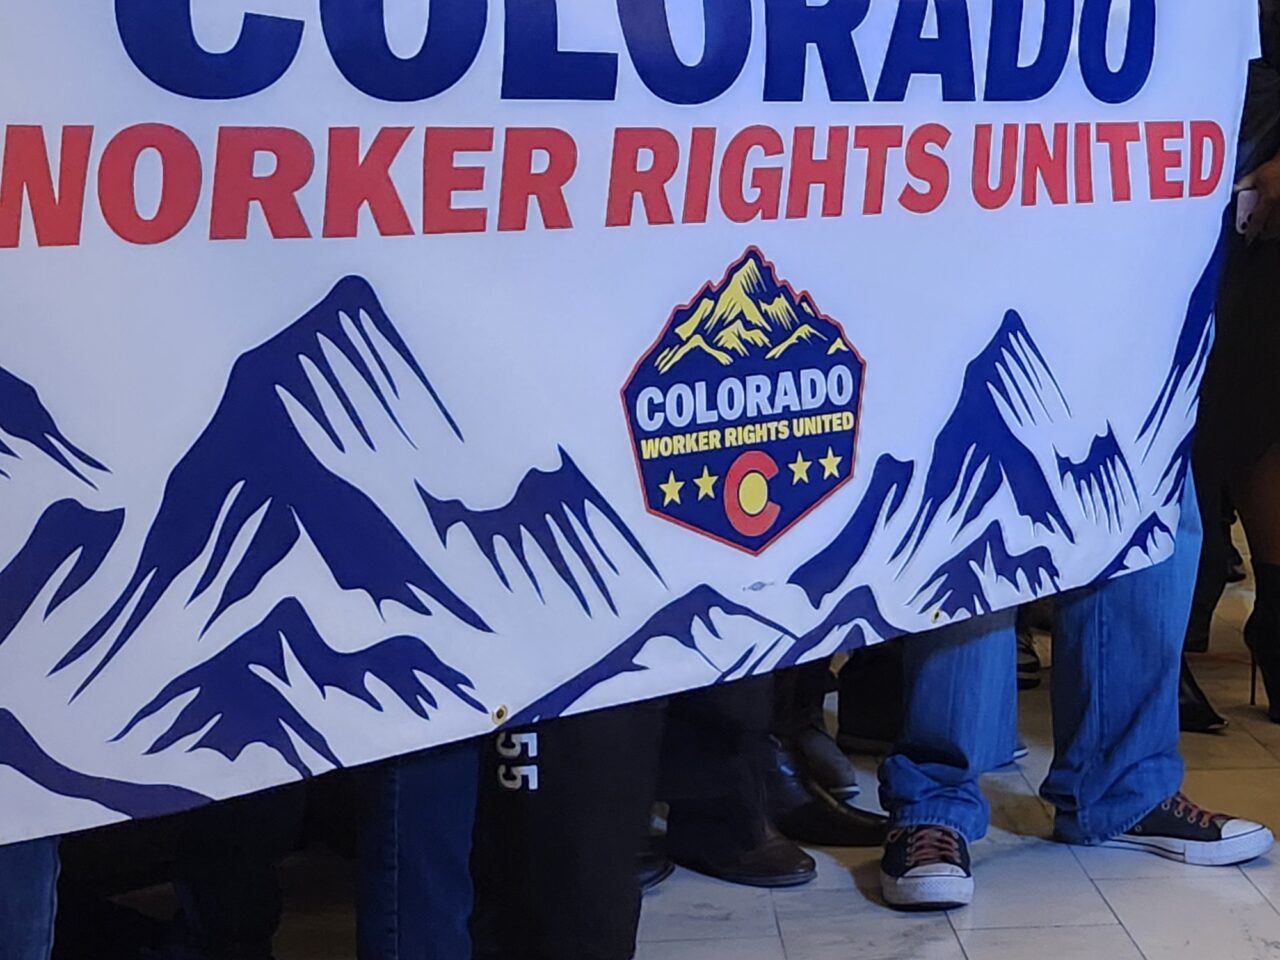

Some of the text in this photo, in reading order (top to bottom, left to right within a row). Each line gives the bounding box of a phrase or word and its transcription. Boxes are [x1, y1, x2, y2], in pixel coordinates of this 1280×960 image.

[605, 123, 950, 229] RIGHTS
[971, 120, 1226, 205] UNITED
[636, 365, 853, 431] COLORADO
[640, 411, 854, 459] WORKER RIGHTS UNITED
